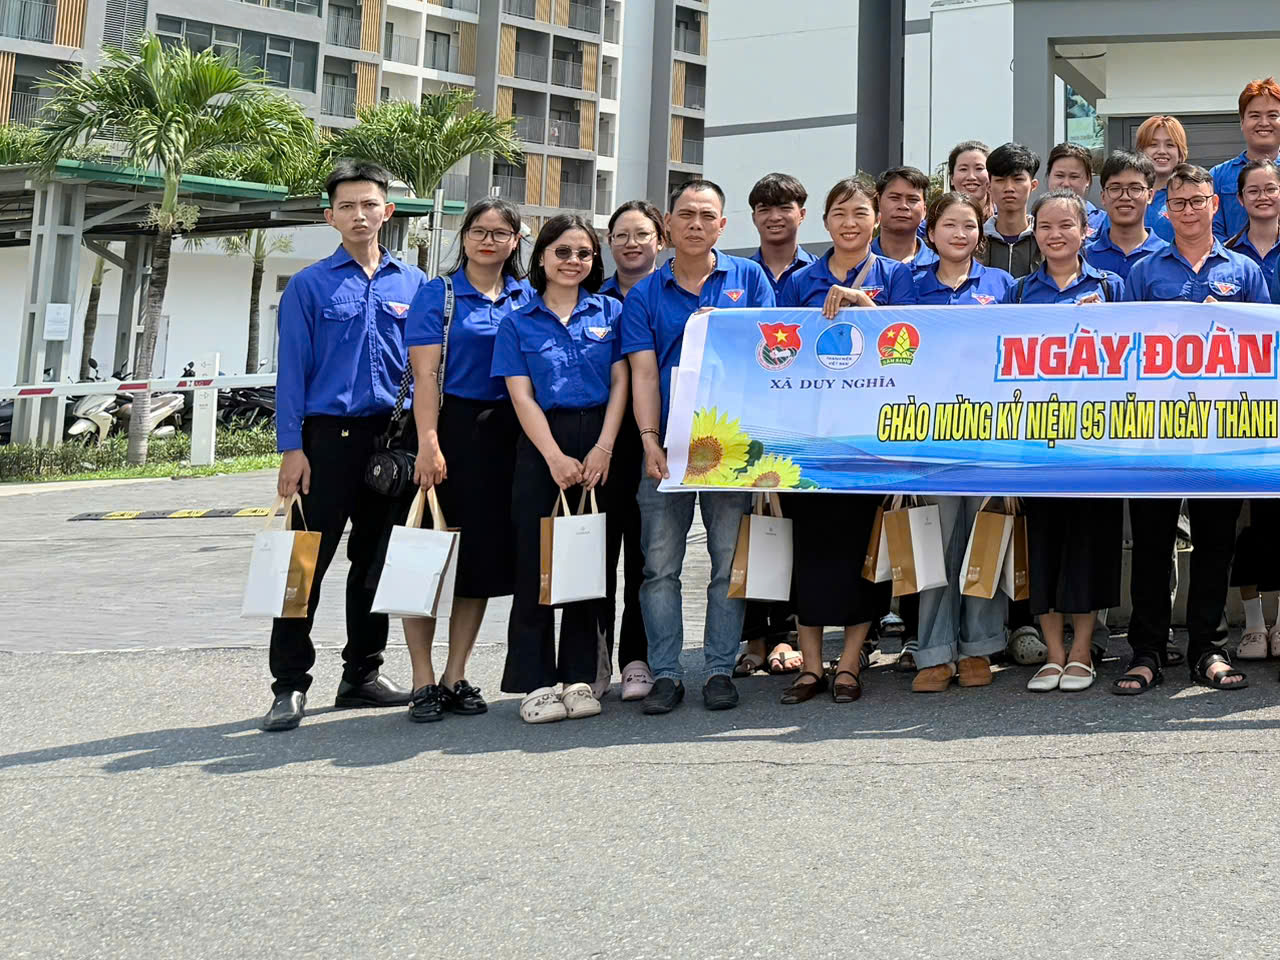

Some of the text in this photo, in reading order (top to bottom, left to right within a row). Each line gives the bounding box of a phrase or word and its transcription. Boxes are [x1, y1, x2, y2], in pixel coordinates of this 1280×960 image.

[998, 325, 1133, 378] NGÀY
[1139, 324, 1275, 378] ĐOÀN
[770, 375, 896, 390] XÃ DUY NGHĨA
[877, 395, 931, 442] CHÀO
[933, 395, 993, 441] MỪNG
[995, 389, 1024, 440] KỶ
[1025, 393, 1077, 448] NIỆM
[1081, 401, 1106, 440] 95
[1109, 392, 1155, 439] NĂM
[1159, 392, 1212, 439] NGÀY
[1214, 391, 1278, 439] THÀNH
